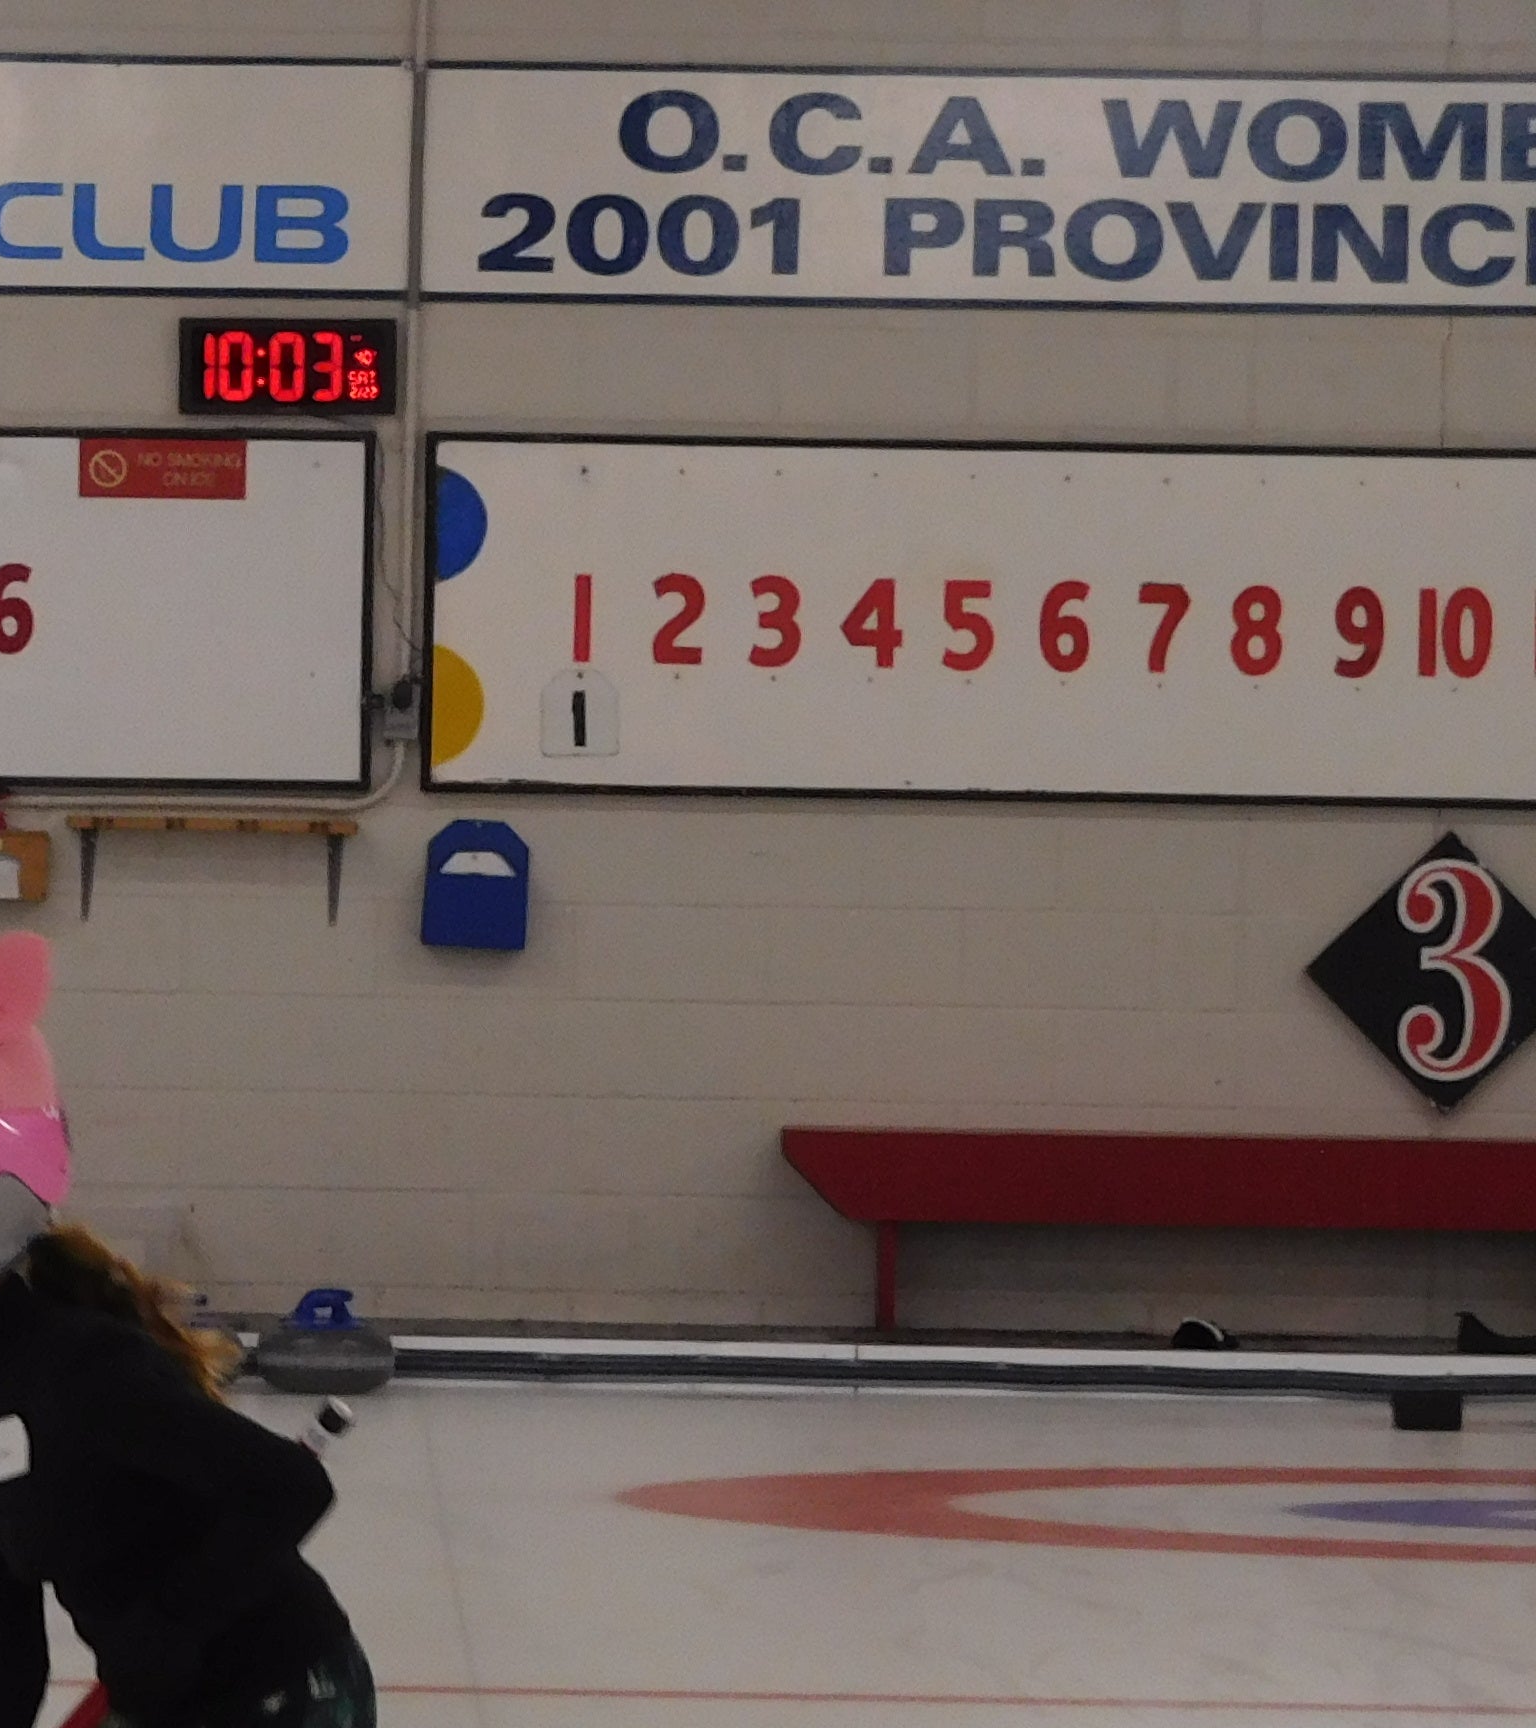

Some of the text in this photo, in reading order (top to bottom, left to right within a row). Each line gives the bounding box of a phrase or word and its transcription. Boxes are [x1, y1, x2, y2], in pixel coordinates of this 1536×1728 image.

[617, 88, 1046, 177] O.C.A.
[477, 193, 801, 277] 2001
[203, 331, 345, 402] 10:03
[572, 572, 1495, 679] 1 2 3 4 5 6 7 8 9 10
[571, 689, 588, 748] 1
[1396, 857, 1512, 1082] 3
